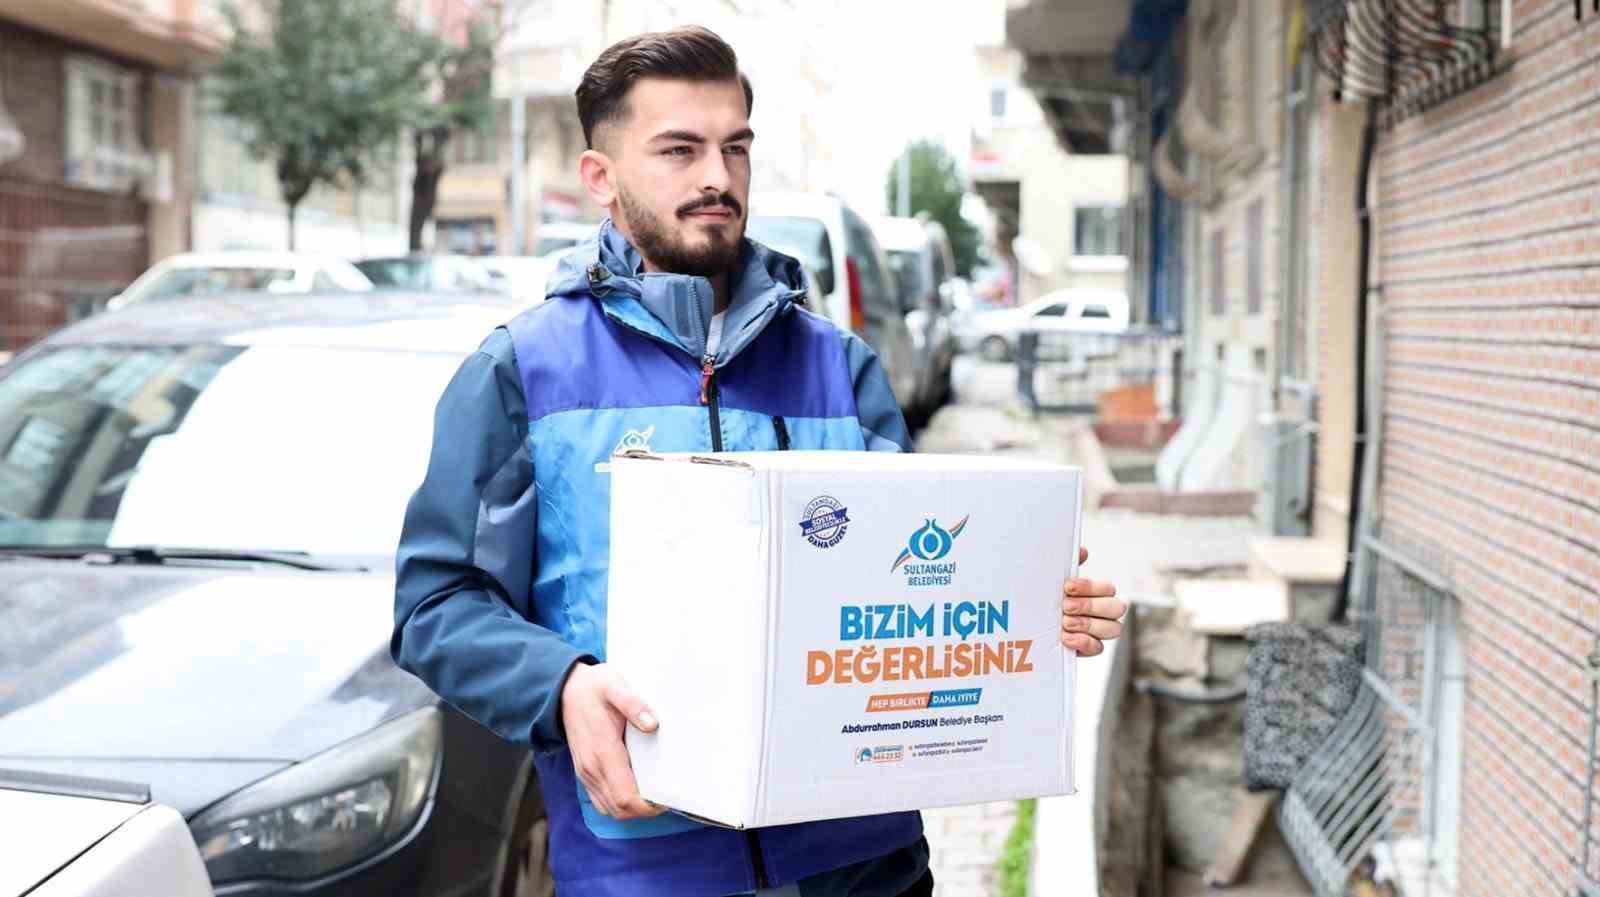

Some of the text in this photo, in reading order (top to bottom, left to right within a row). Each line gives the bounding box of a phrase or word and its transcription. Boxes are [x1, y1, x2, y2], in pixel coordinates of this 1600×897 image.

[904, 560, 956, 575] SULTANGAZİ
[908, 575, 952, 586] BELEDİYESİ
[932, 694, 957, 705] DAHA
[841, 714, 1004, 734] Abdurrahman DURSUN Belediye Başkanı
